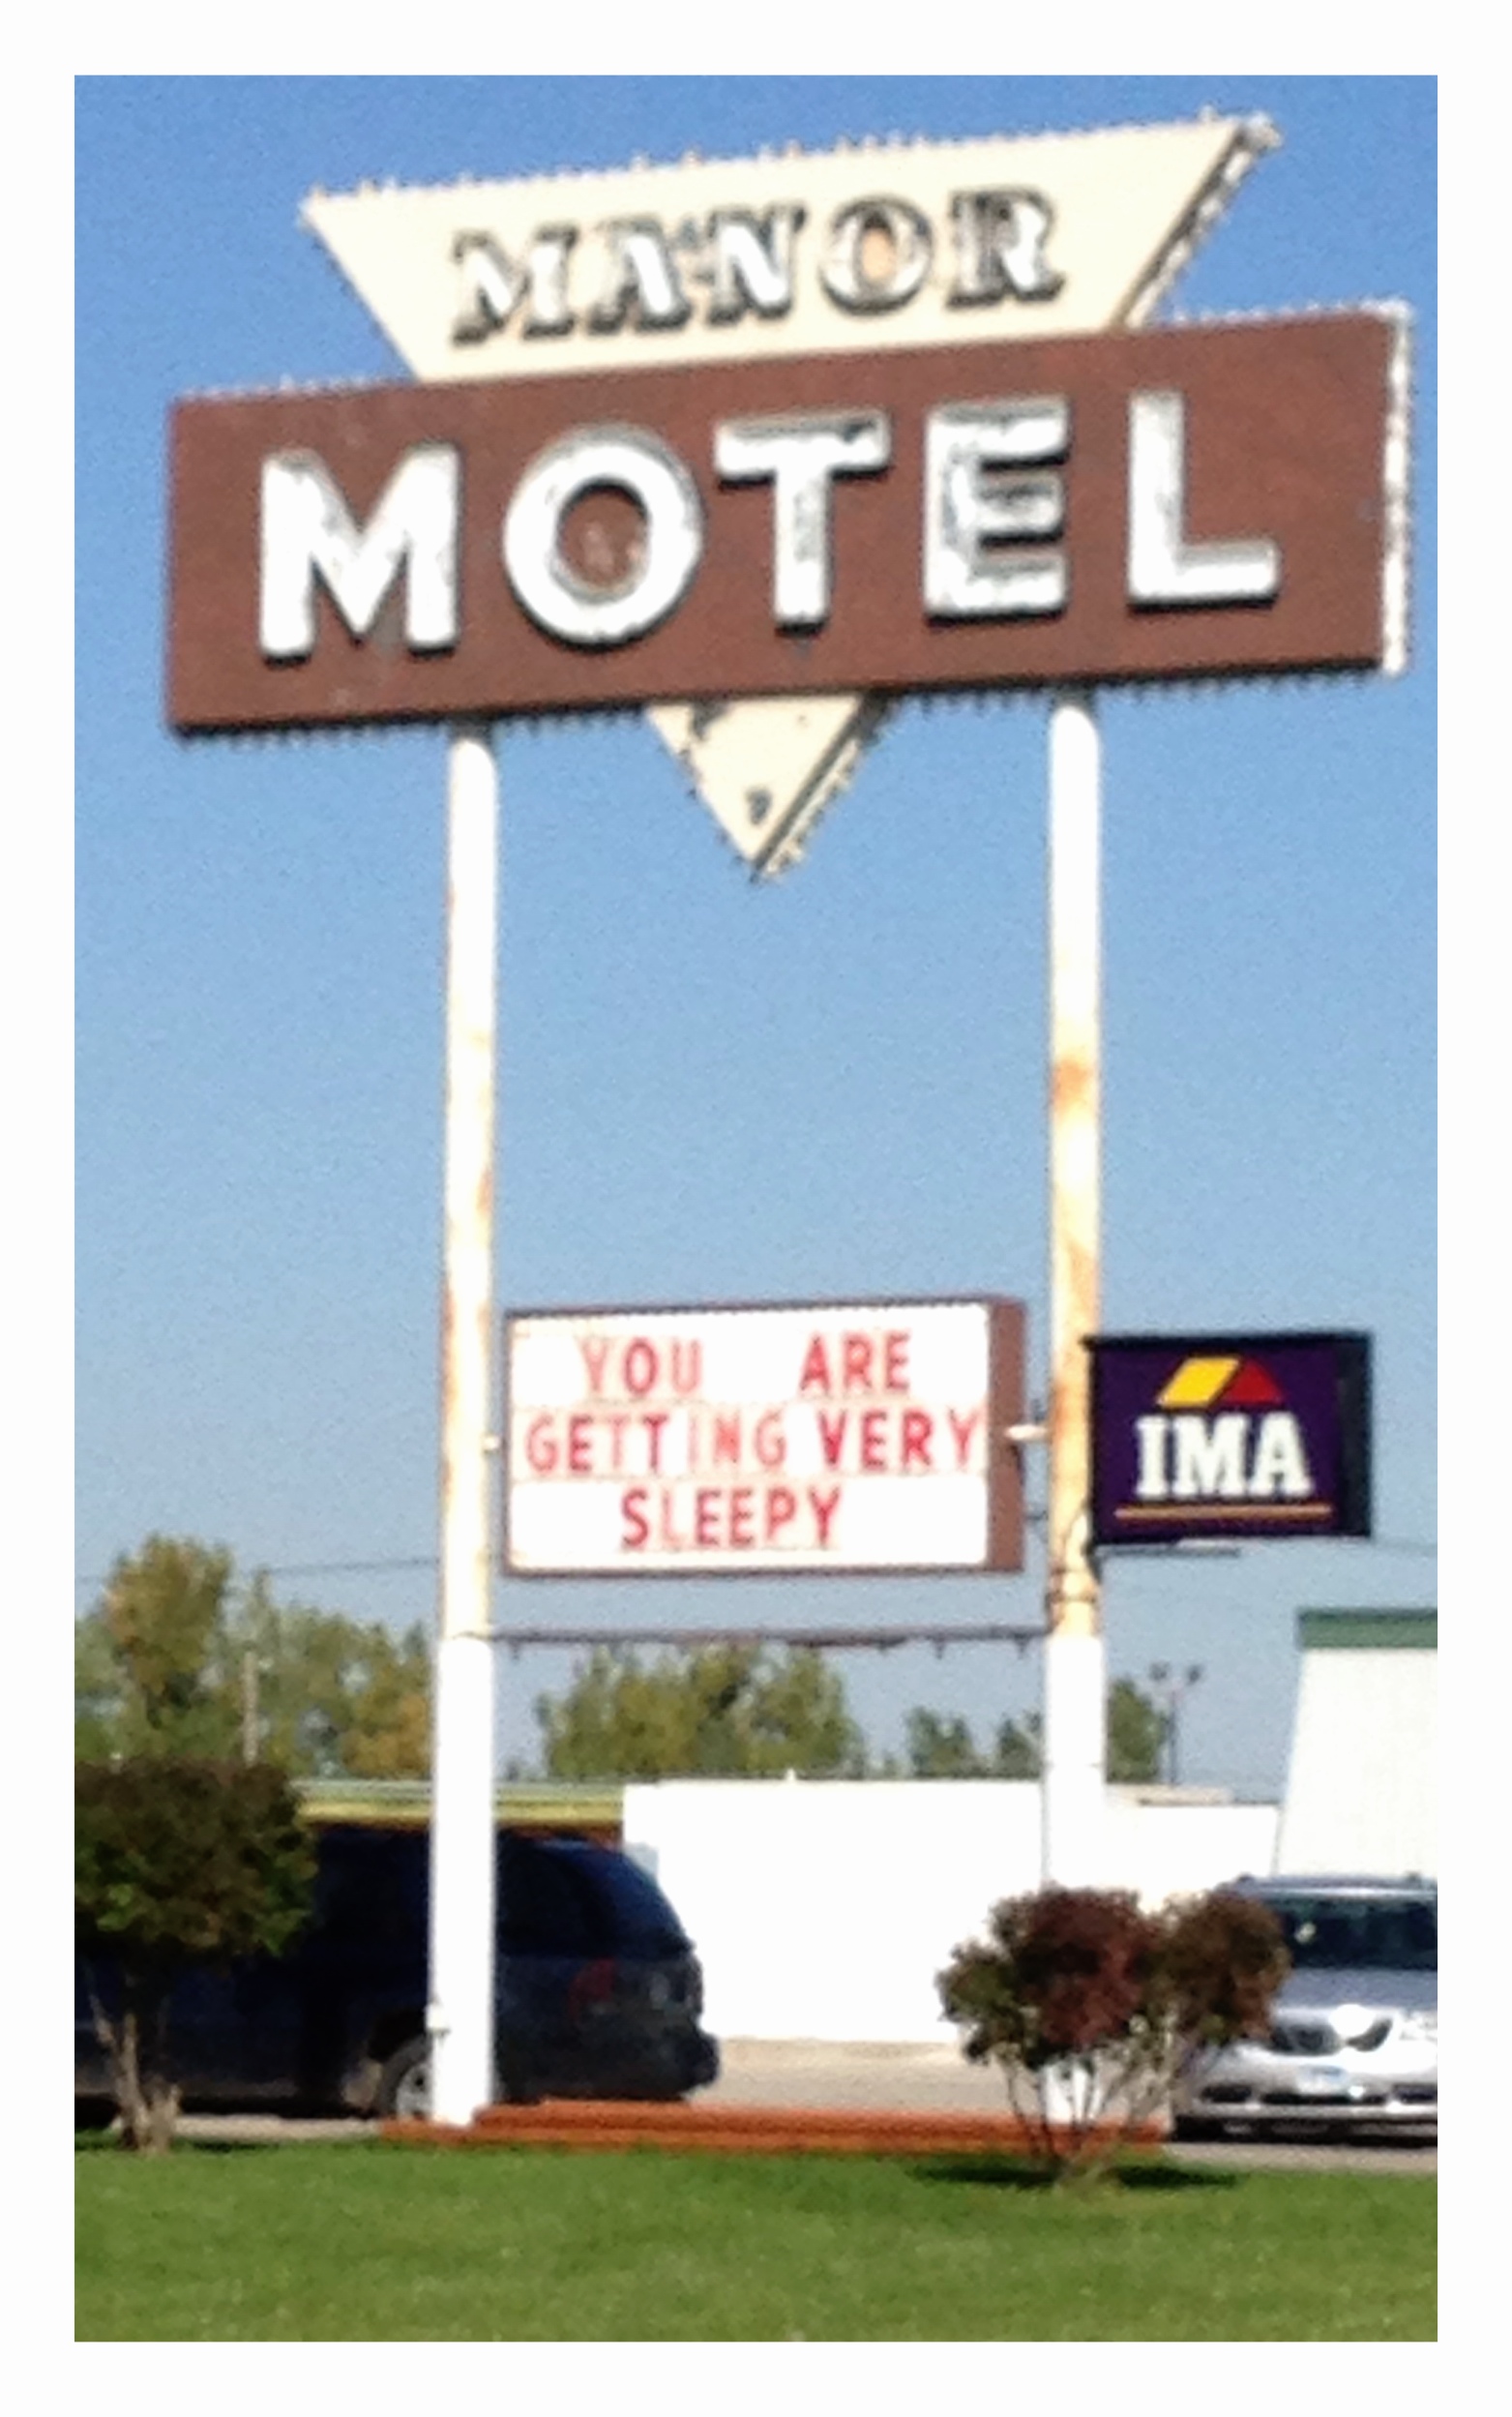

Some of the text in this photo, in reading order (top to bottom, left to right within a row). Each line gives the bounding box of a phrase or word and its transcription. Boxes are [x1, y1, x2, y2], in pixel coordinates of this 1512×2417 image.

[452, 189, 1066, 345] MANOR
[257, 391, 1281, 665] MOTEL
[578, 1330, 911, 1395] YOU ARE
[525, 1408, 982, 1473] GETTING VERY
[1134, 1411, 1315, 1500] IMA
[620, 1485, 842, 1549] SLEEPY
